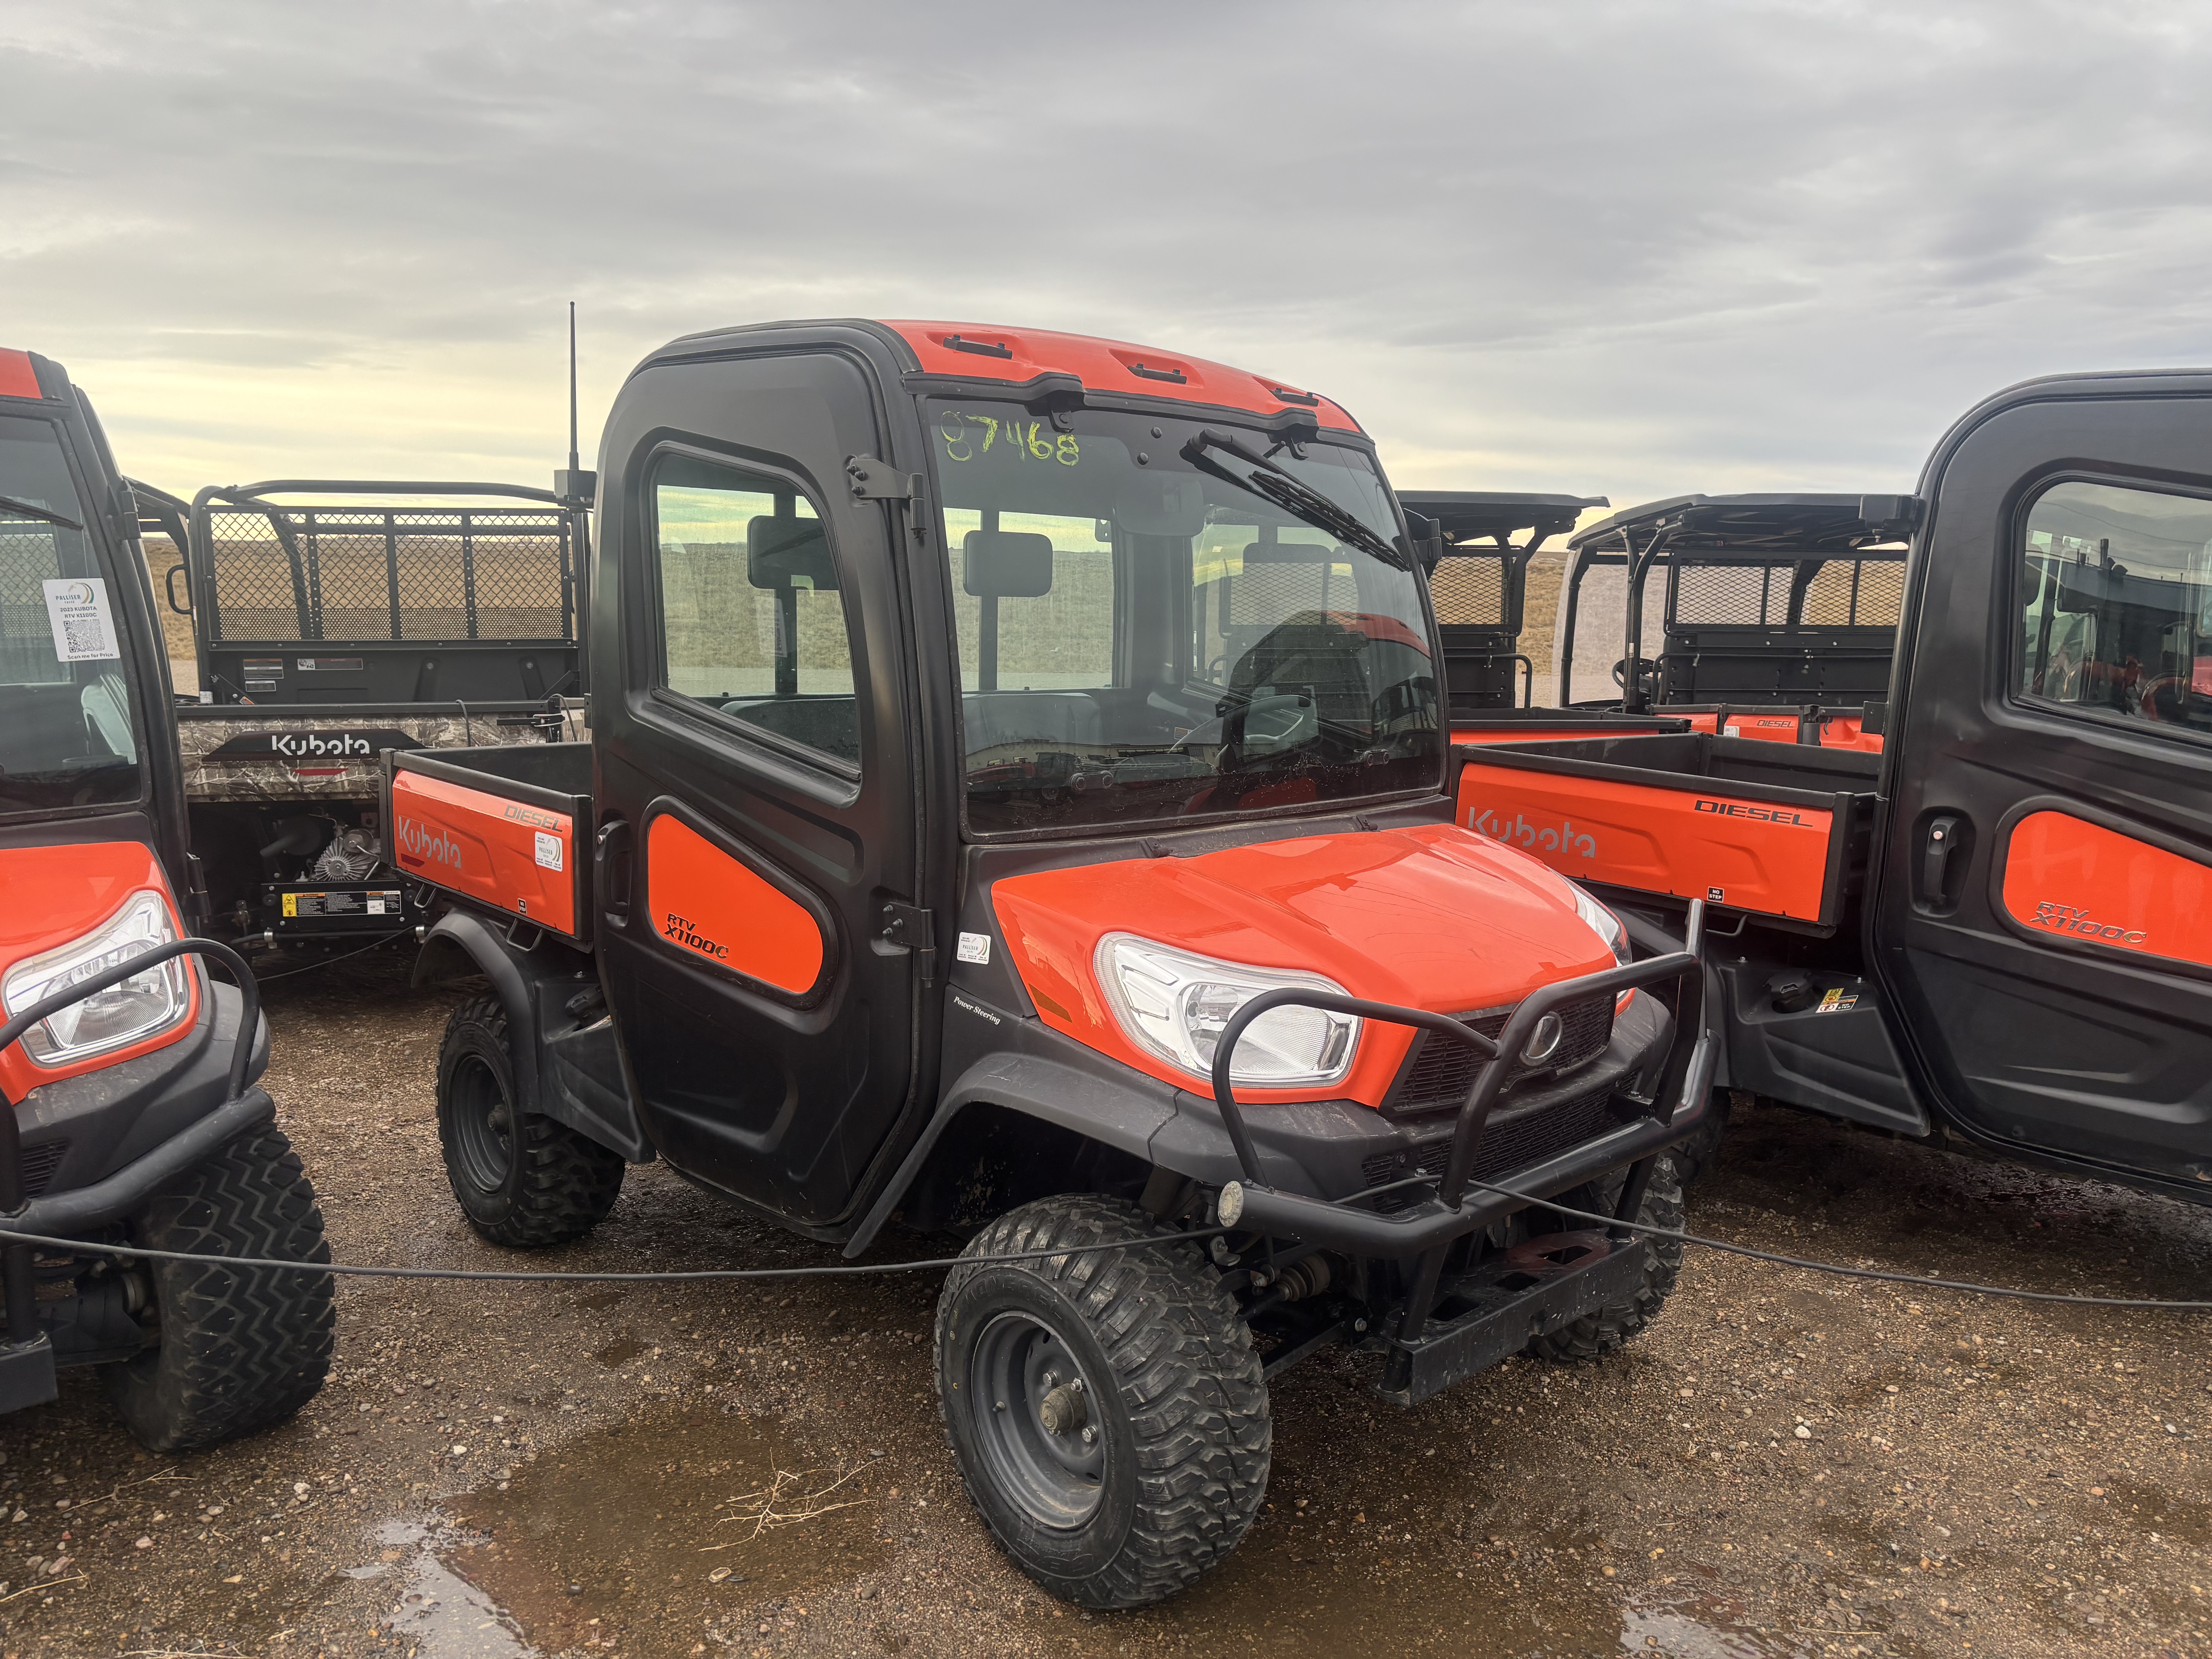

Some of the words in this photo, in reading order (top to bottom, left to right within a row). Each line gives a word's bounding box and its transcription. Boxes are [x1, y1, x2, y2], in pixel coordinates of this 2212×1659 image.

[940, 410, 1079, 466] 87468
[1756, 720, 1794, 728] DIESEL
[272, 734, 370, 756] Kubota
[504, 805, 563, 833] DIESEL
[1694, 800, 1813, 827] DIESEL
[398, 816, 462, 869] Kubota
[1468, 807, 1595, 858] Kubota
[667, 913, 696, 931] RTV
[2037, 901, 2089, 918] RTV
[664, 923, 729, 959] X1100C
[2029, 911, 2147, 944] X1100C
[953, 996, 974, 1011] Power
[973, 1006, 1001, 1025] Steering
